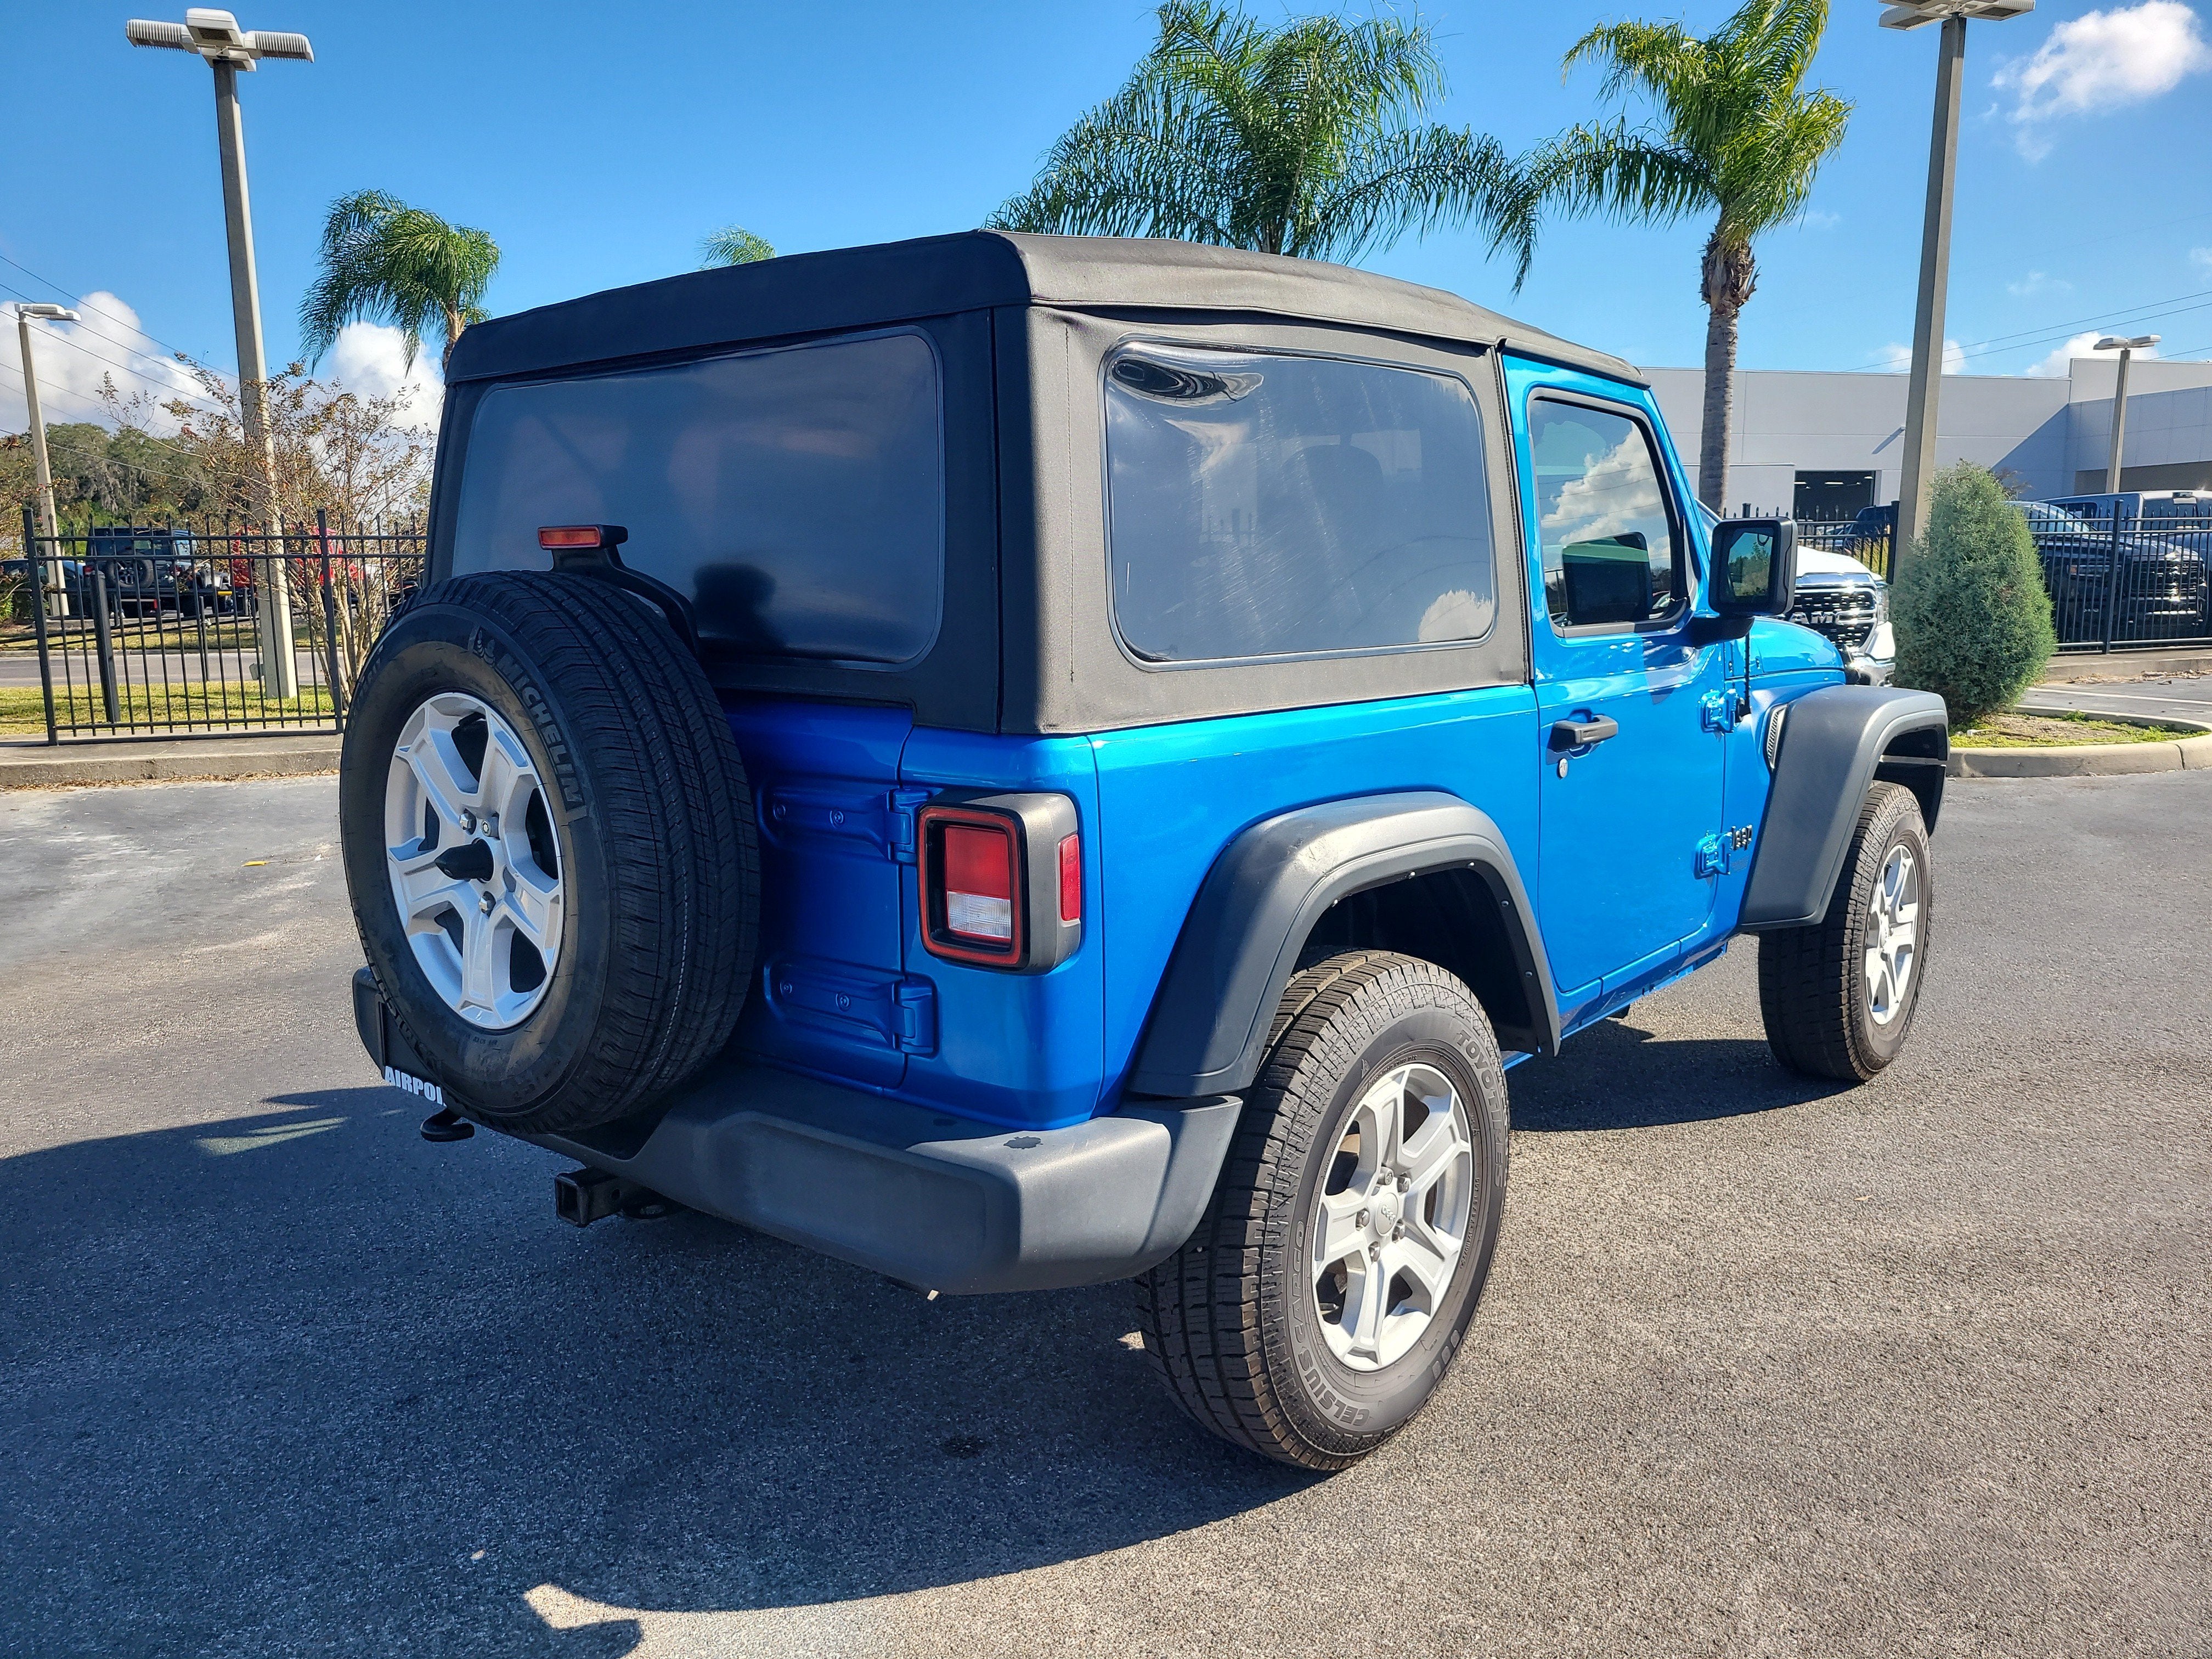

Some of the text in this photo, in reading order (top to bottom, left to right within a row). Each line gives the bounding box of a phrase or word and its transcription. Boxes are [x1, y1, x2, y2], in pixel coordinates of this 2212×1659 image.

[1778, 611, 1833, 624] AM
[496, 653, 583, 802] MICHELIN
[1457, 1029, 1494, 1090] TOYO
[1292, 1221, 1306, 1344] CARGO
[1297, 1346, 1370, 1426] CELSIUS
